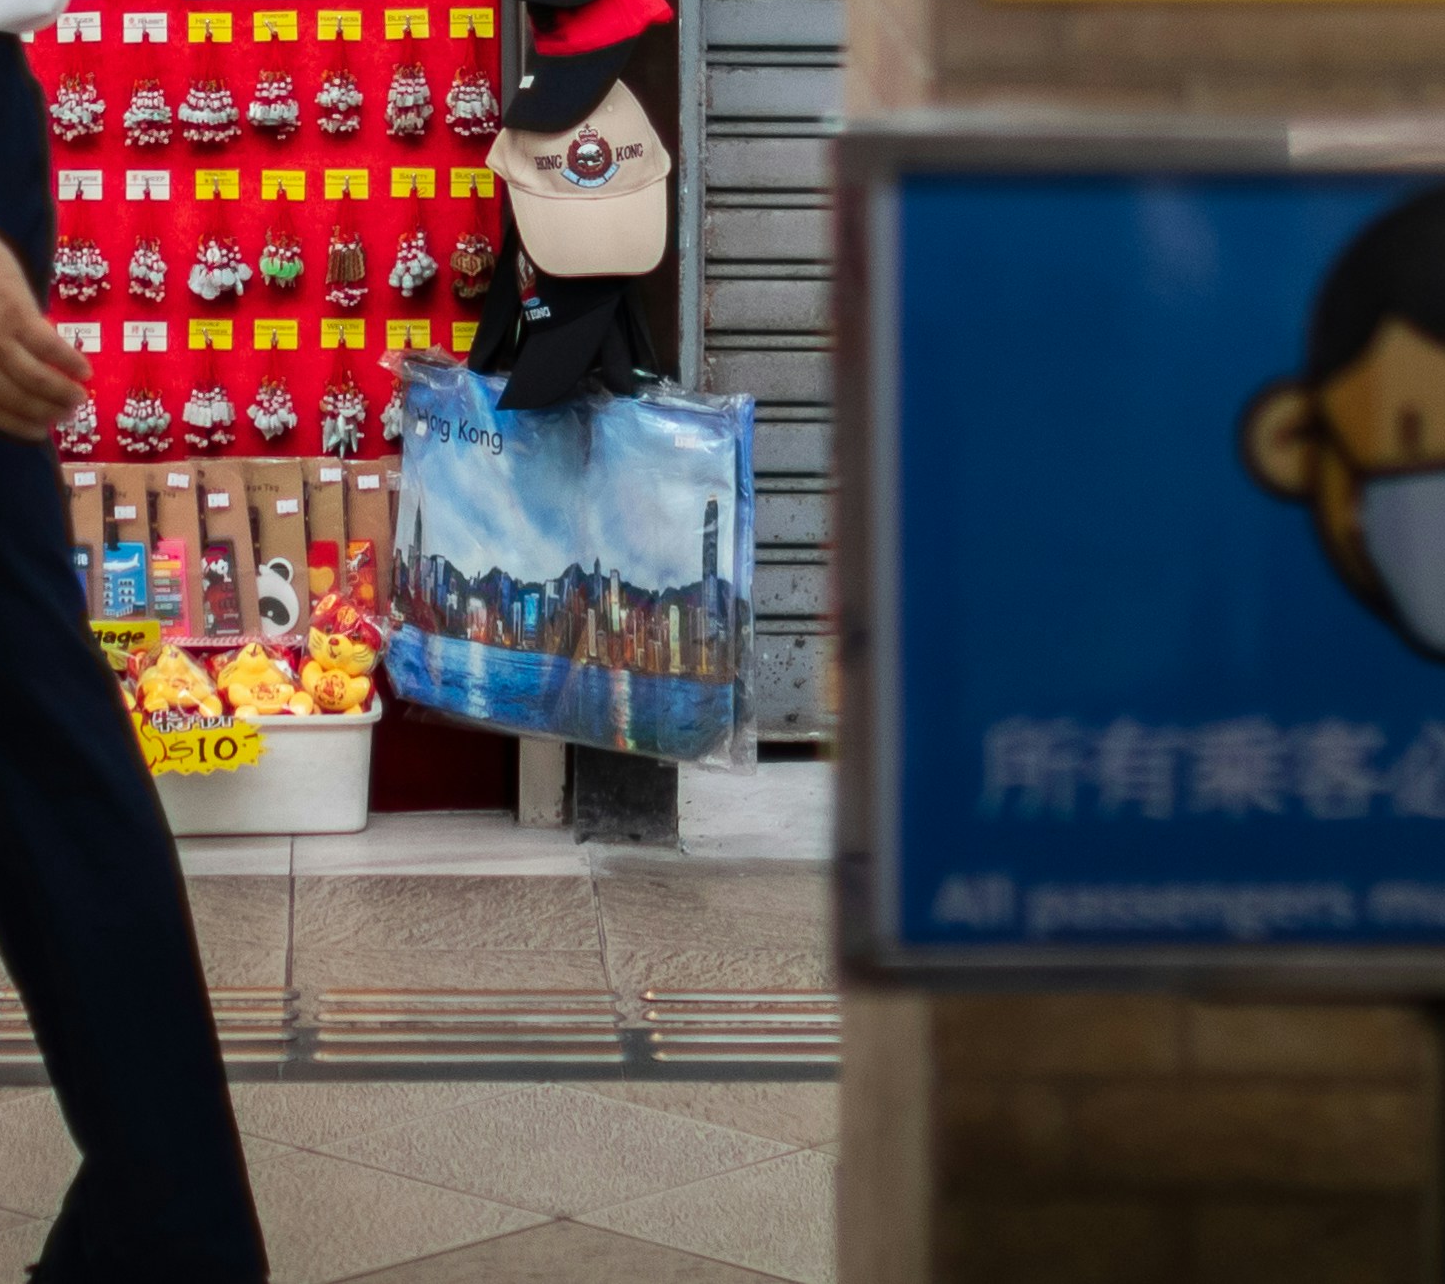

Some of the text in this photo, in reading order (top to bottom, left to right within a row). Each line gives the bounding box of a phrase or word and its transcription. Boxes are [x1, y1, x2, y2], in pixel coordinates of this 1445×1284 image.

[533, 143, 644, 170] HONG KONG
[416, 406, 504, 453] Hong Kong
[932, 877, 1016, 929] All
